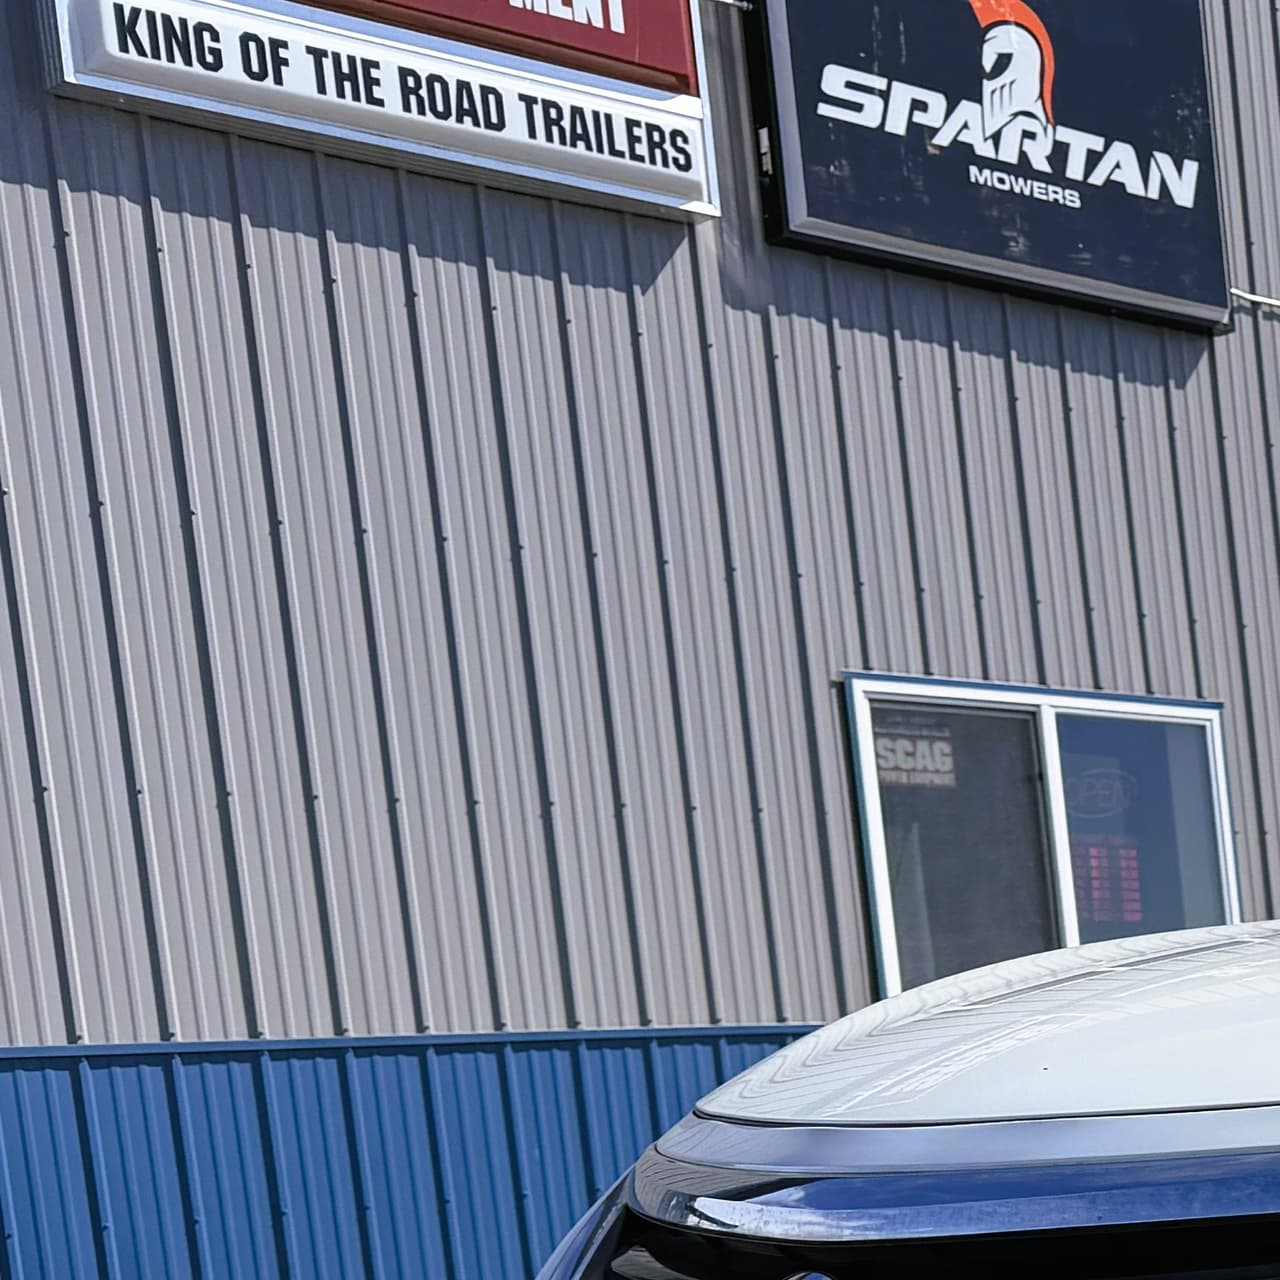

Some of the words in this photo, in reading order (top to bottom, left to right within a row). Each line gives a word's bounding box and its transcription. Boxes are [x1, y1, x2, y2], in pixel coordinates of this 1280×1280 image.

[114, 3, 223, 72] KING
[239, 31, 291, 84] OF
[305, 46, 385, 109] THE
[397, 65, 506, 132] ROAD
[518, 92, 692, 173] TRAILERS
[816, 64, 1199, 208] SPARTAN
[969, 164, 1081, 208] MOWERS
[876, 737, 953, 772] SCAG
